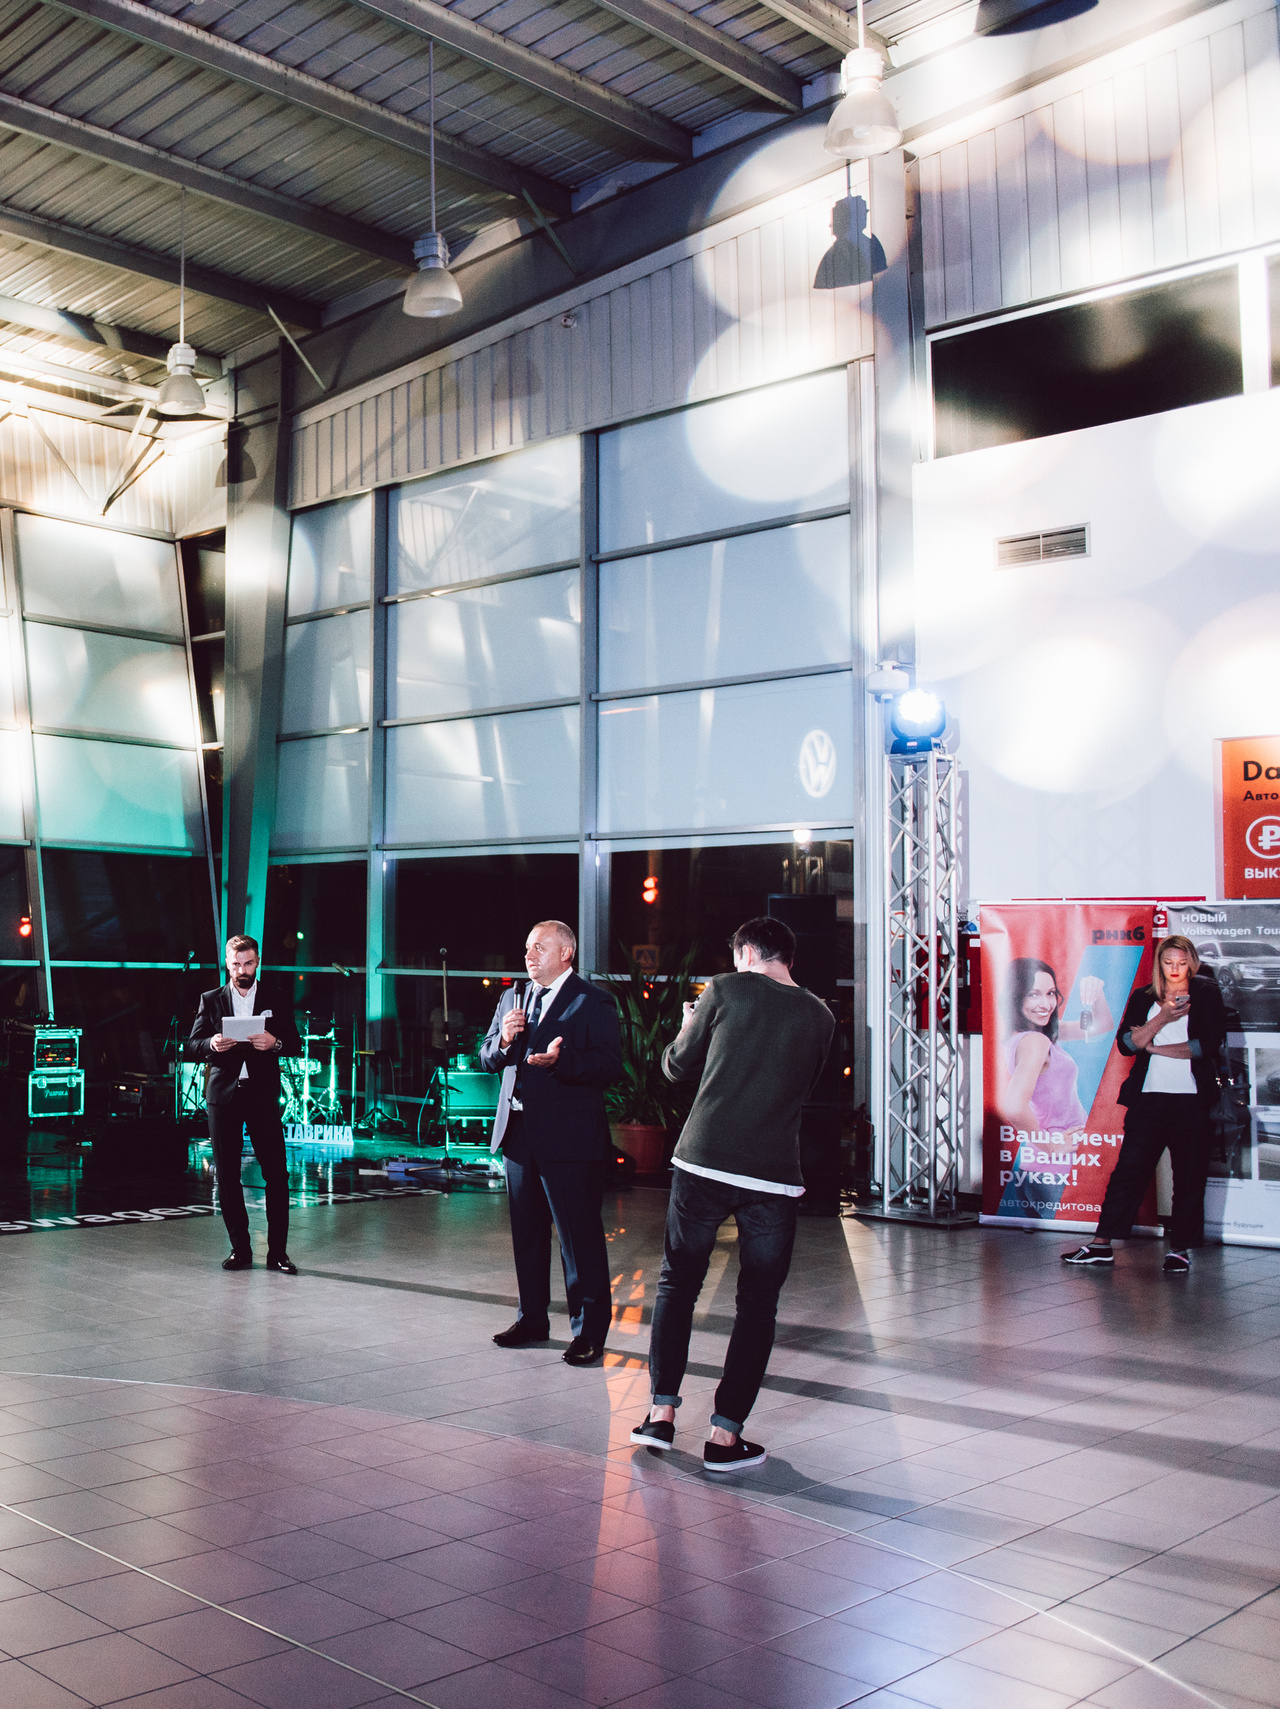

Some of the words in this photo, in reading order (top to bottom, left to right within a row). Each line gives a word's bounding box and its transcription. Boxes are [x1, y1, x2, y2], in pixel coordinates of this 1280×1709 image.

[1243, 761, 1280, 781] Da
[1244, 868, 1280, 879] ВЫК
[1181, 912, 1228, 923] НОВЫЙ
[1092, 926, 1145, 944] рнкб
[1181, 926, 1251, 936] Volkswagen
[1256, 926, 1280, 935] Tou
[285, 1123, 352, 1142] ТАВРИКА
[1000, 1125, 1066, 1145] Ваша
[1072, 1132, 1125, 1147] мечт
[1000, 1149, 1013, 1162] в
[1020, 1146, 1102, 1167] Ваших
[1000, 1169, 1078, 1187] руках!
[999, 1199, 1102, 1213] автокредитова
